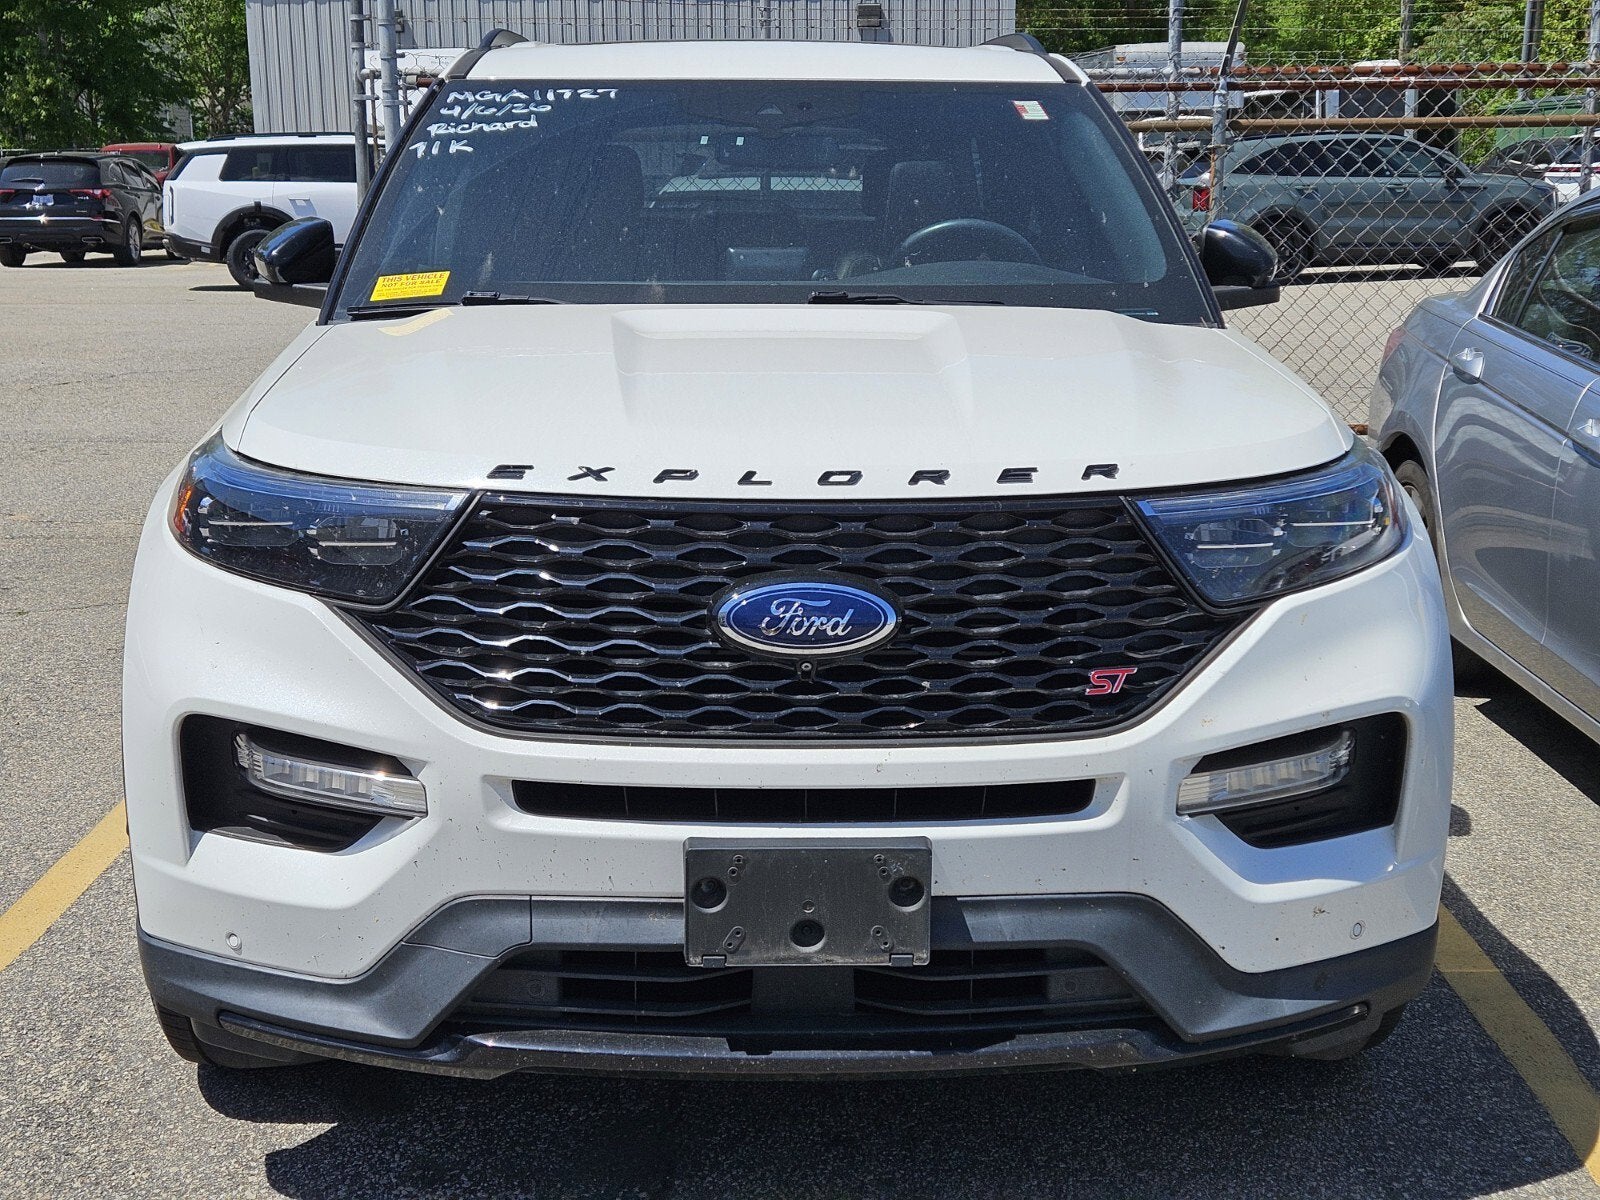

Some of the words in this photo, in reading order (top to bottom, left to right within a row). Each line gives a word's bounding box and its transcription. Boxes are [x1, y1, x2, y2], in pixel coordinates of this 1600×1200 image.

[427, 114, 538, 137] Richard
[405, 273, 445, 281] VEHICLE
[485, 463, 1121, 487] EXPLORER
[761, 597, 855, 636] Ford
[1085, 667, 1138, 696] ST
